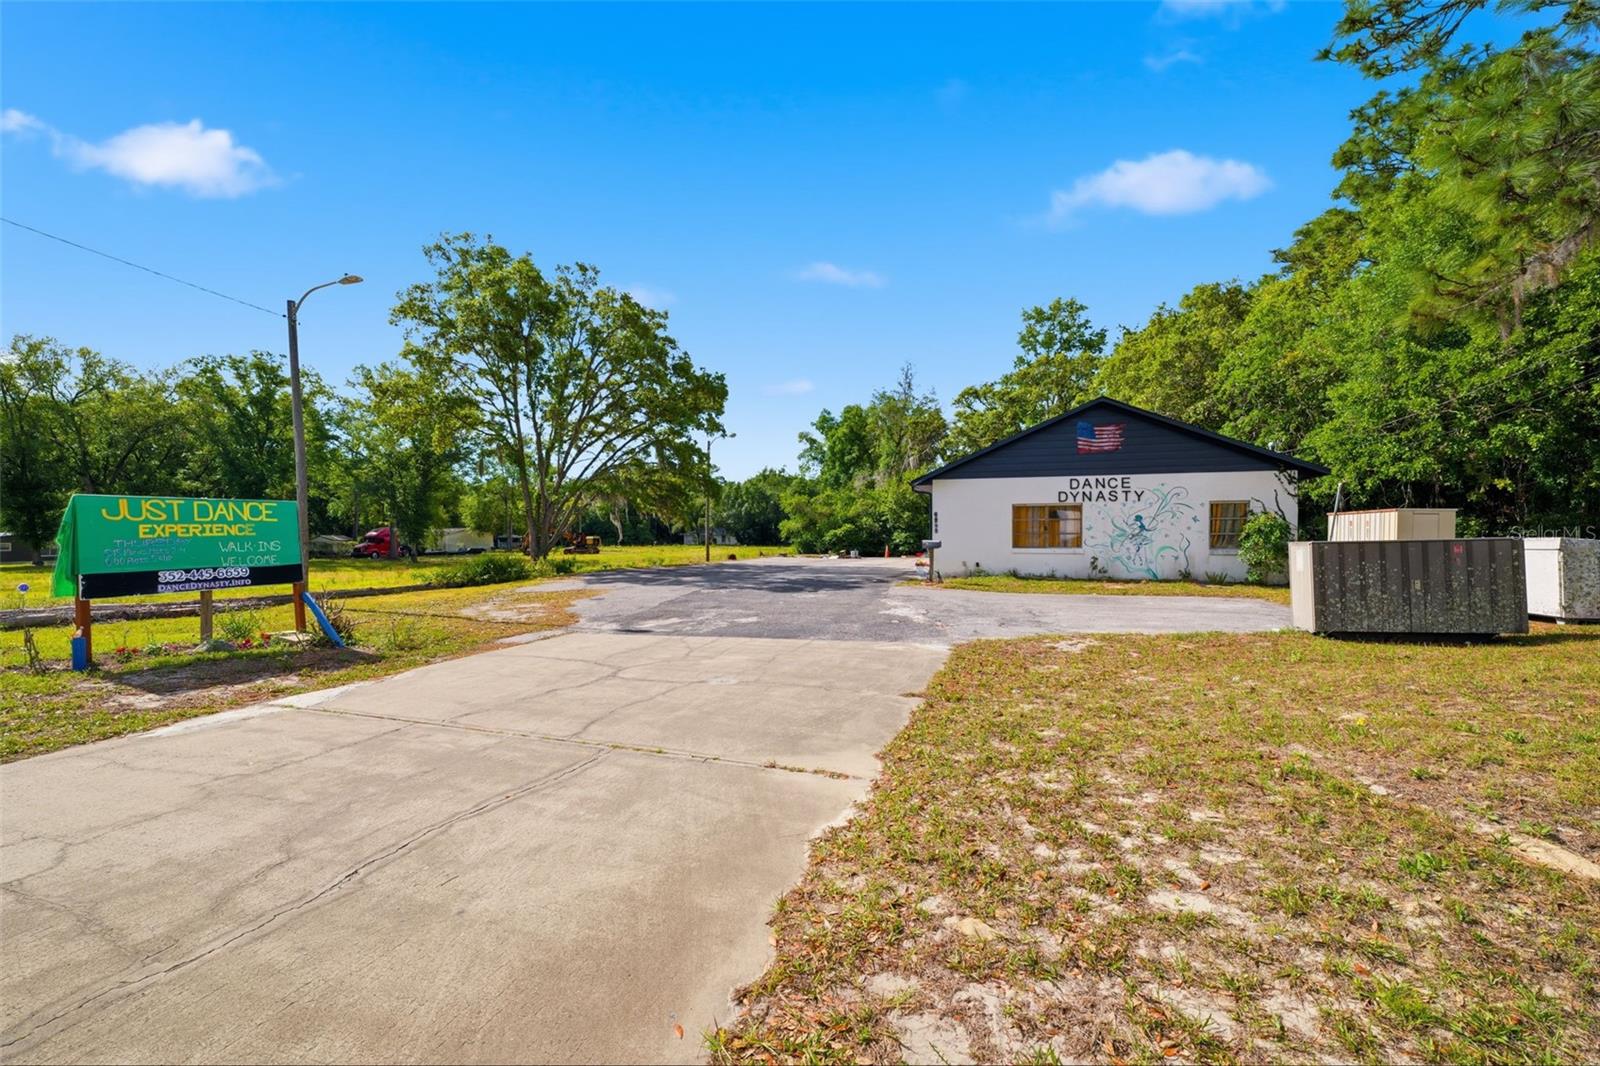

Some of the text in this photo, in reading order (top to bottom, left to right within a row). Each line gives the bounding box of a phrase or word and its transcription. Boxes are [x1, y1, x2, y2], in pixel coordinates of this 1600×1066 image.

[1069, 477, 1131, 490] DANCE
[1058, 490, 1145, 502] DYNASTY
[101, 498, 279, 522] JUST DANCE
[138, 523, 256, 538] EXPERIENCE
[220, 554, 279, 567] WELCOME
[157, 567, 250, 583] 352-445-6659
